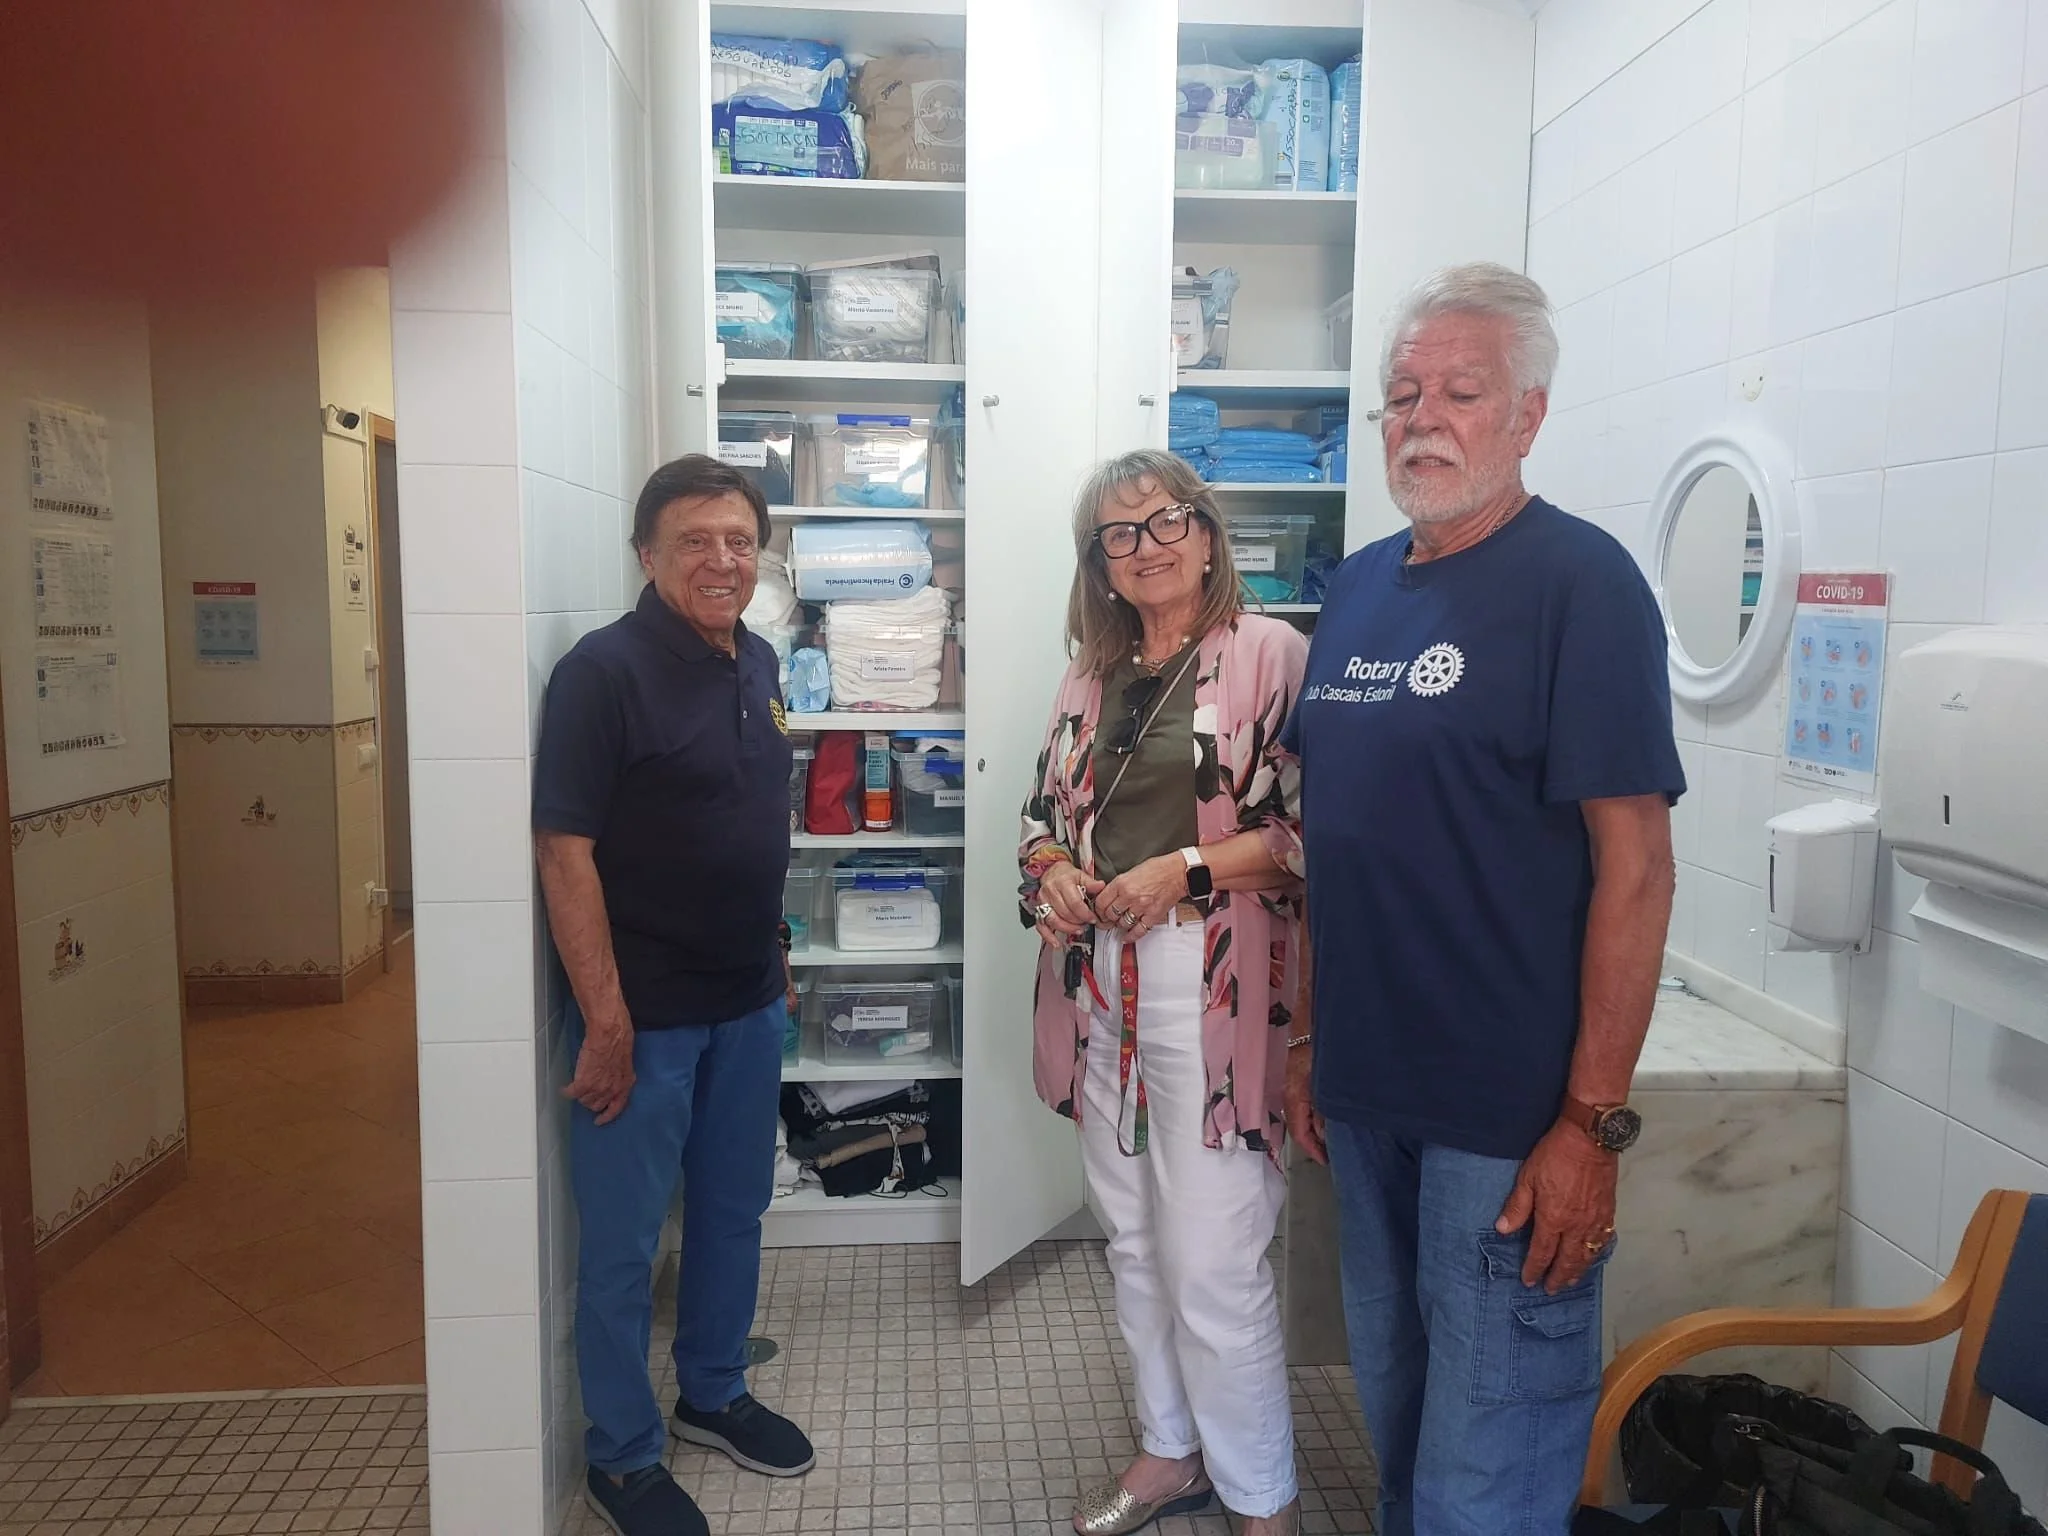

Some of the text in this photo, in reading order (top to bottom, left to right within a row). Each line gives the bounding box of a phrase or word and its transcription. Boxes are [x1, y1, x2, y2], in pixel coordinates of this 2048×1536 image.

[905, 157, 964, 175] Mais par
[1816, 584, 1864, 600] COVID-19
[1344, 656, 1408, 683] Rotary
[1321, 683, 1362, 703] Cascais
